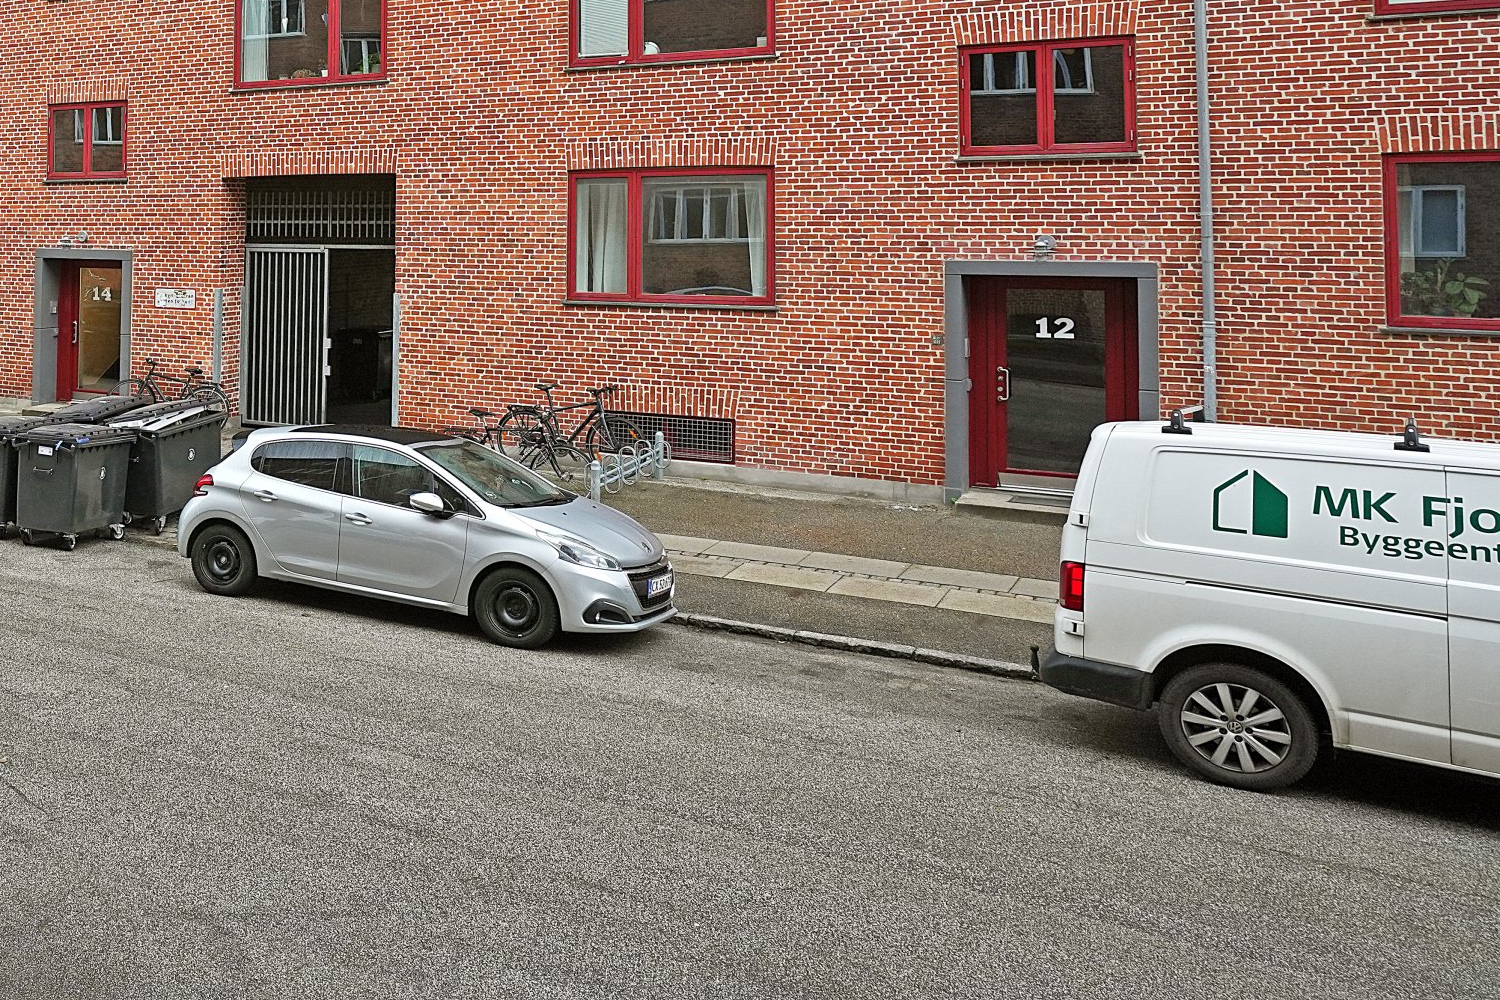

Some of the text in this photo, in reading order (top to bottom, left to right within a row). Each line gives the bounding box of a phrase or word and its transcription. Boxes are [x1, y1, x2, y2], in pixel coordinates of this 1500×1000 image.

[92, 286, 112, 301] 14
[1035, 317, 1075, 339] 12
[1313, 485, 1399, 523] MK
